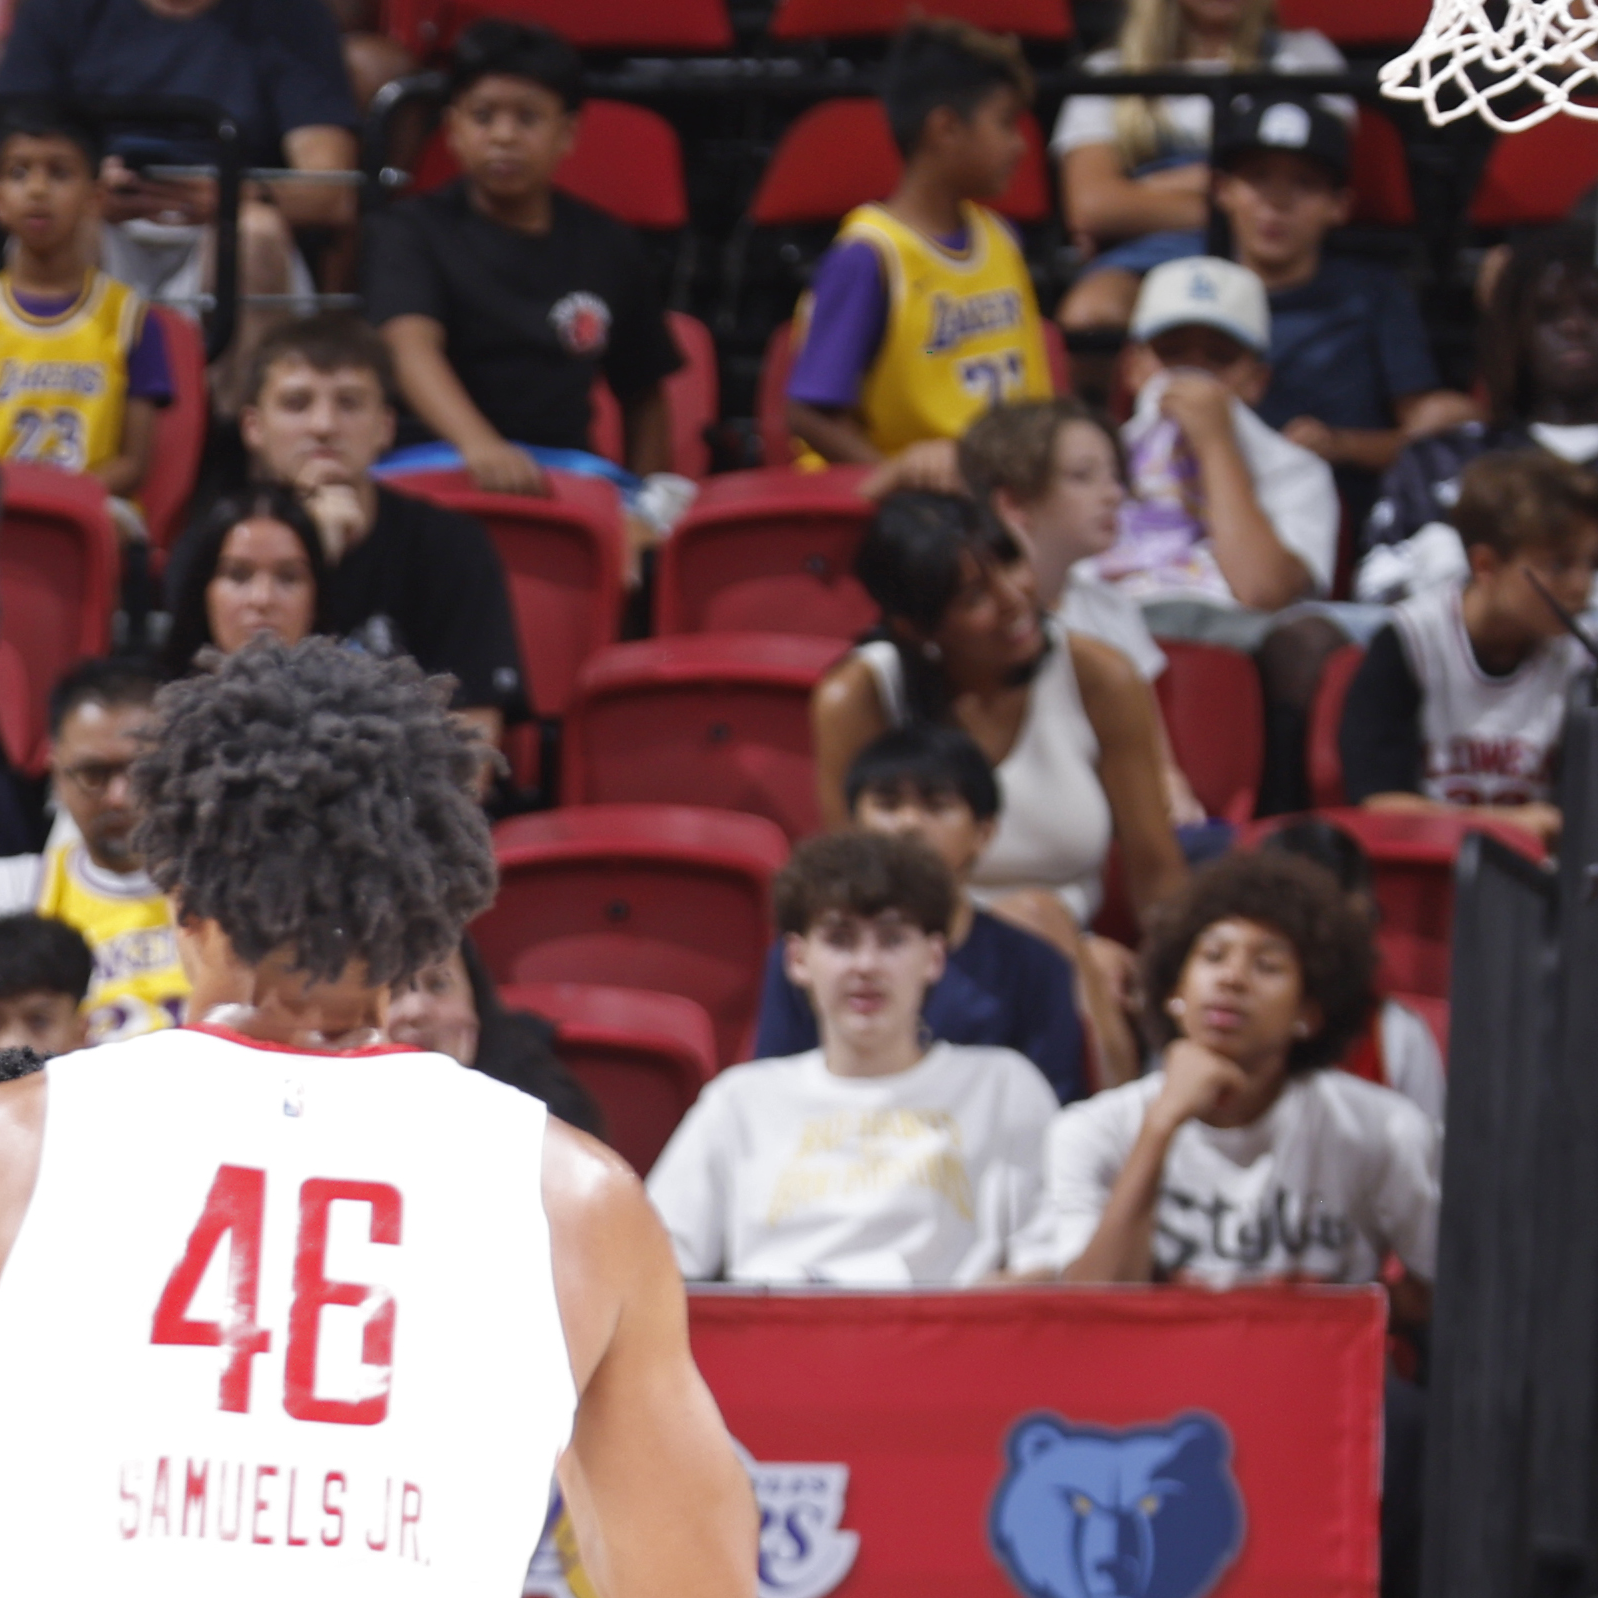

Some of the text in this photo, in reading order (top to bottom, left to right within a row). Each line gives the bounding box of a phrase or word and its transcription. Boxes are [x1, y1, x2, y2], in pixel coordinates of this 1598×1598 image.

[150, 1163, 403, 1426] 46
[118, 1456, 431, 1567] SAMUELS JR.
